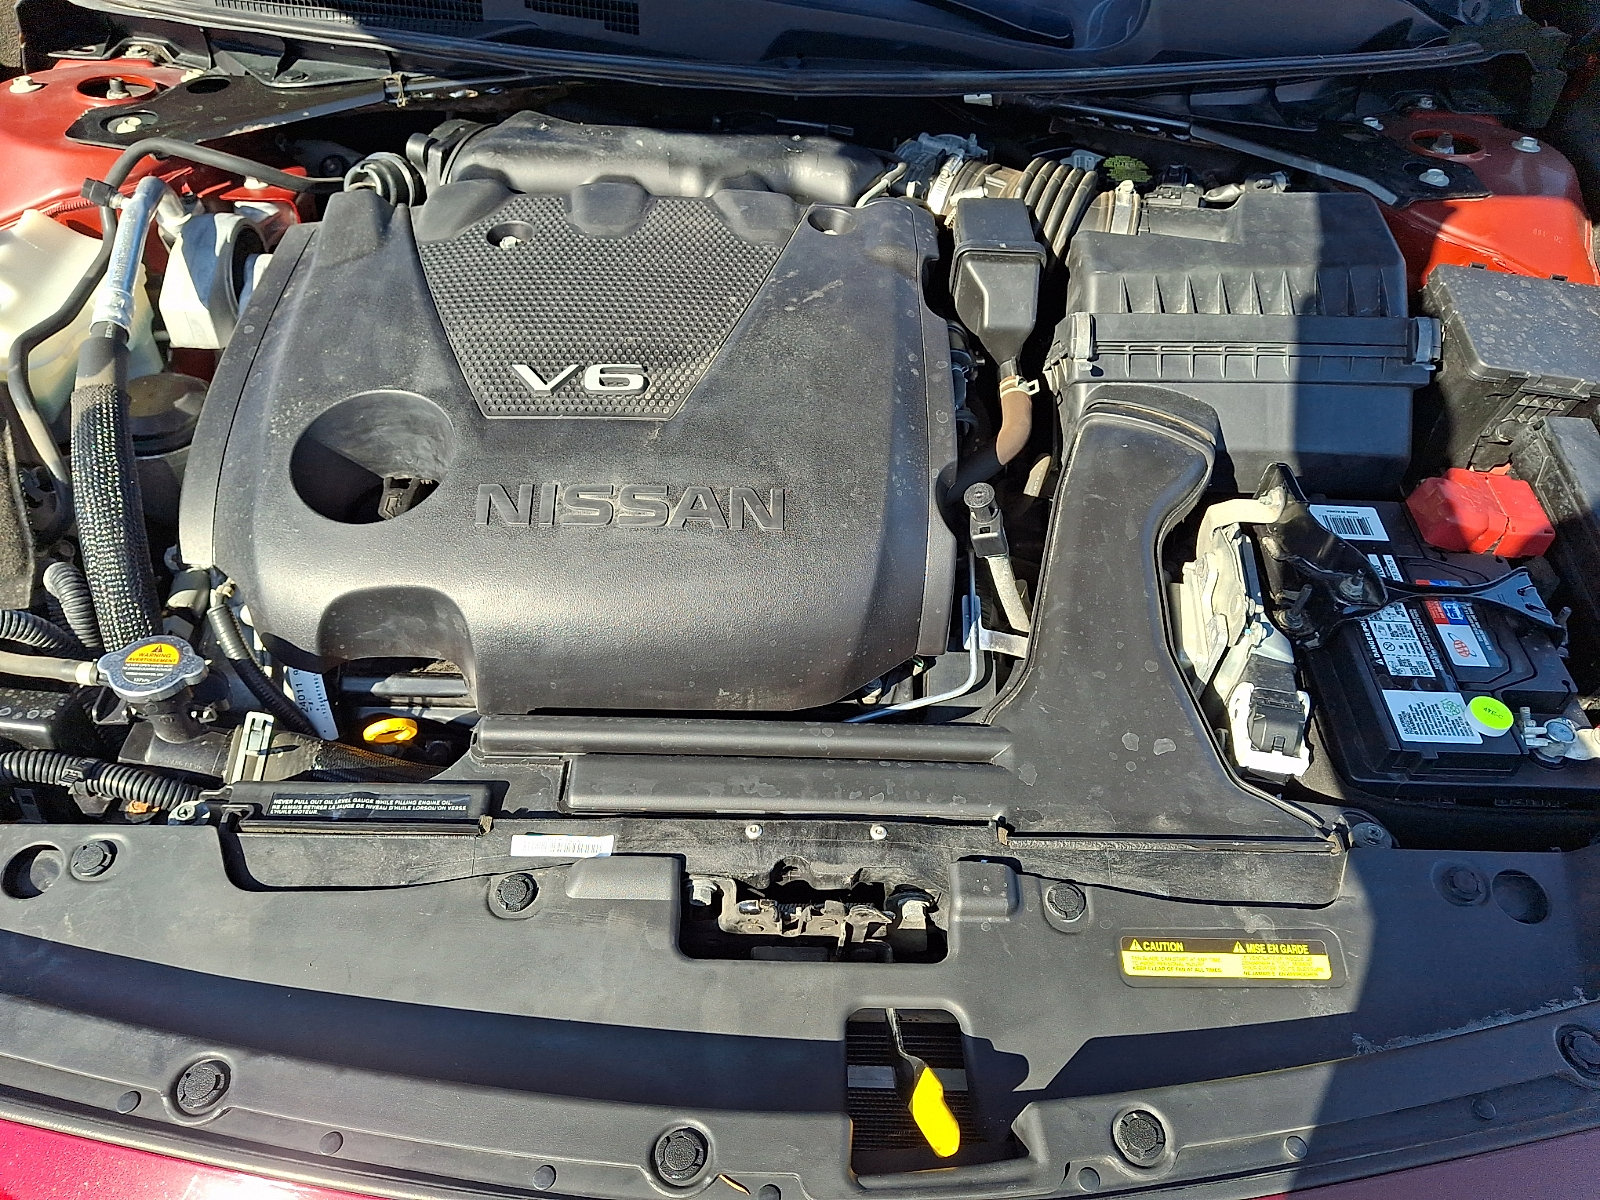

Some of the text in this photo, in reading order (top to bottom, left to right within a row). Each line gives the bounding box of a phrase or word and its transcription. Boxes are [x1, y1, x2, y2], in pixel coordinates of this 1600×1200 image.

[511, 363, 650, 396] V6
[475, 483, 785, 531] NISSAN
[295, 683, 309, 713] 24011
[1143, 941, 1310, 954] CAUTION MISE EN GARDE
